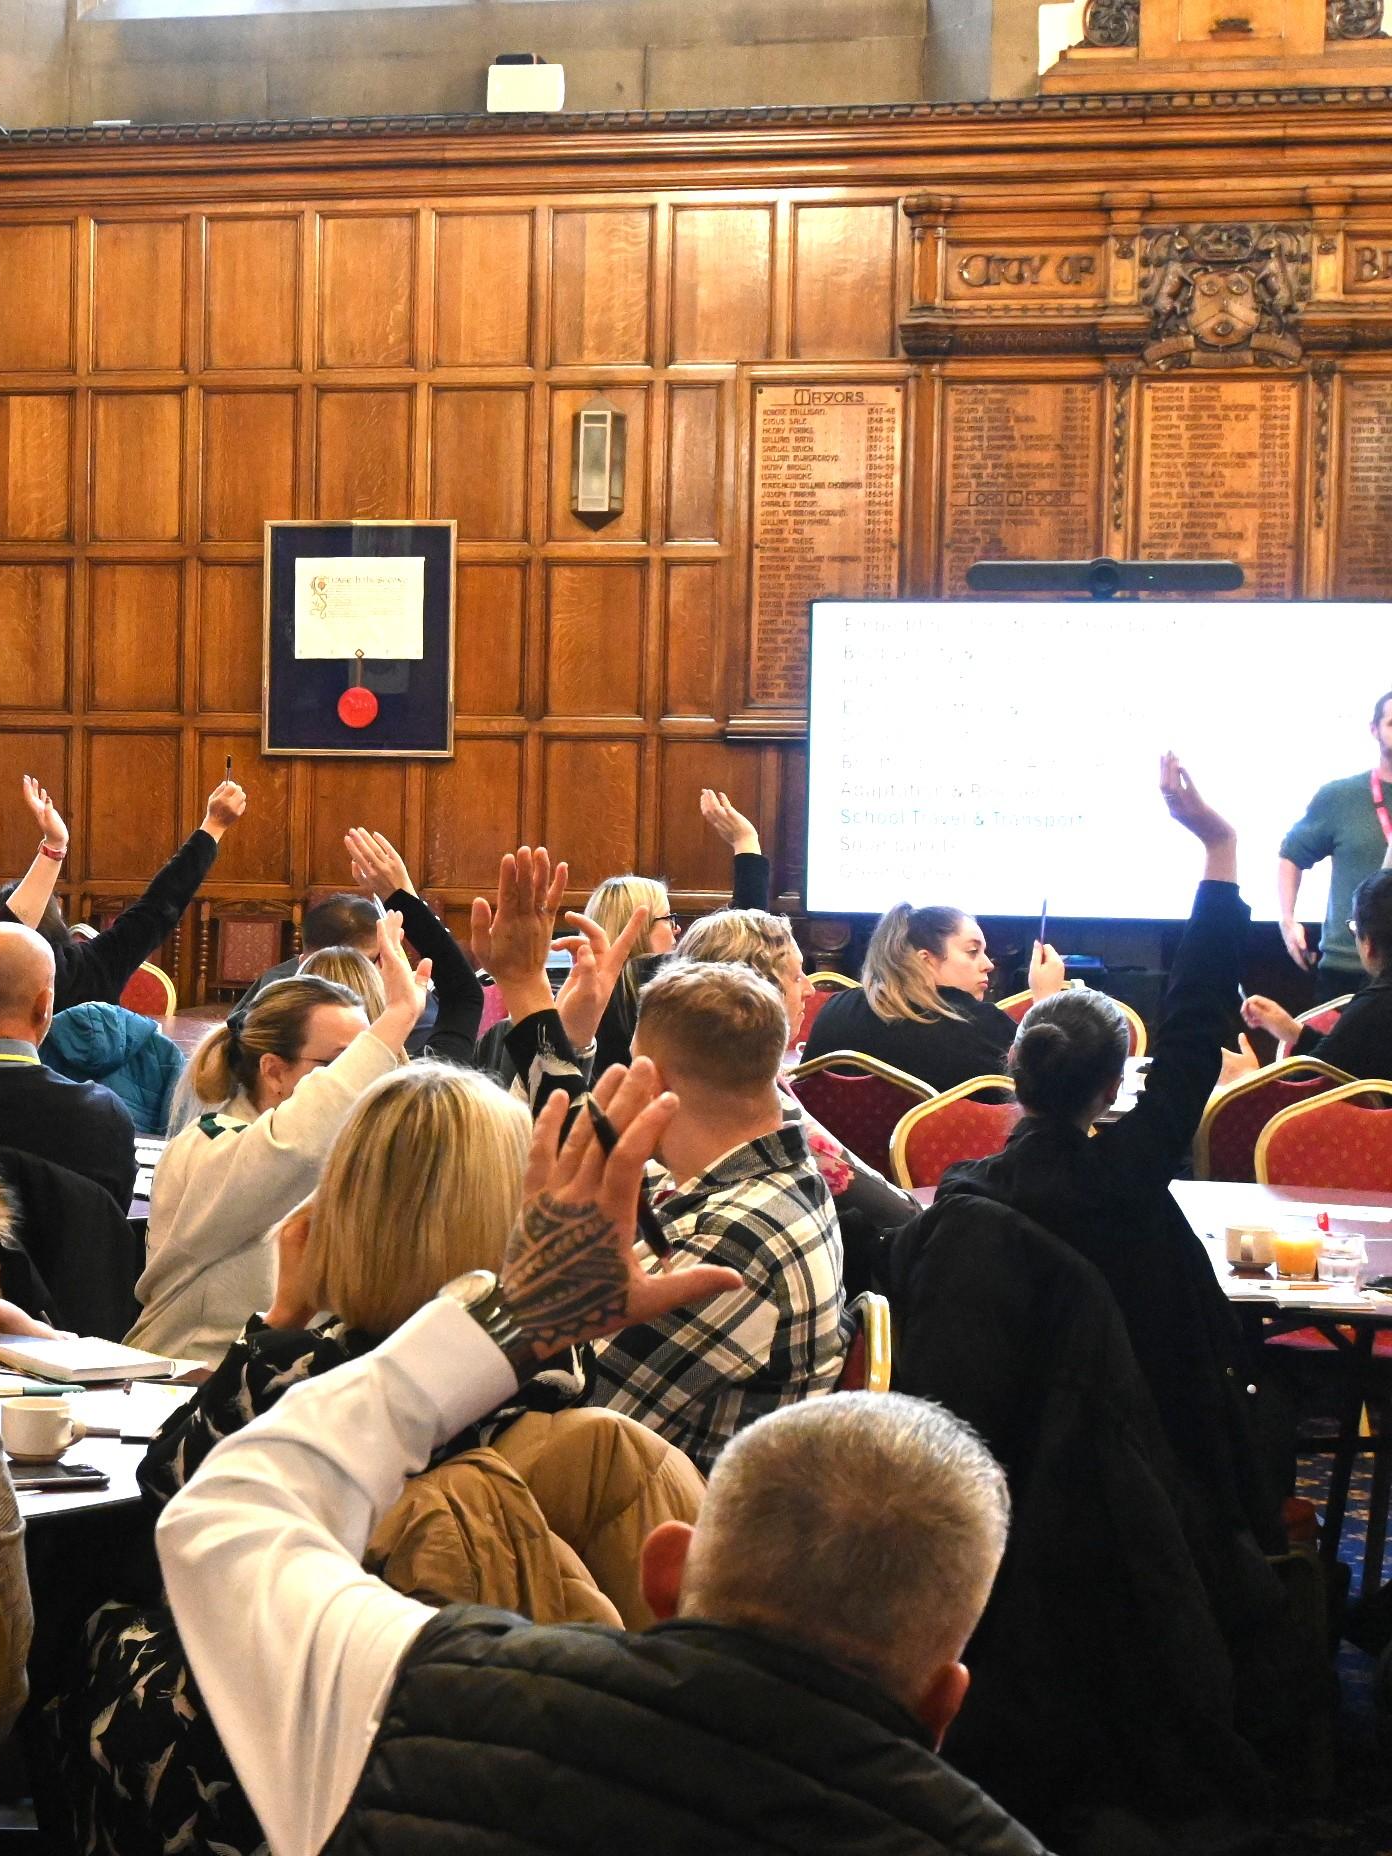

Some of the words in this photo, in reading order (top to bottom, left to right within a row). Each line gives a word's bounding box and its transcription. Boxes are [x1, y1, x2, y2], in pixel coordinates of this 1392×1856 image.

[1056, 256, 1096, 284] OF
[794, 389, 865, 405] MAYORS
[840, 808, 905, 825] School
